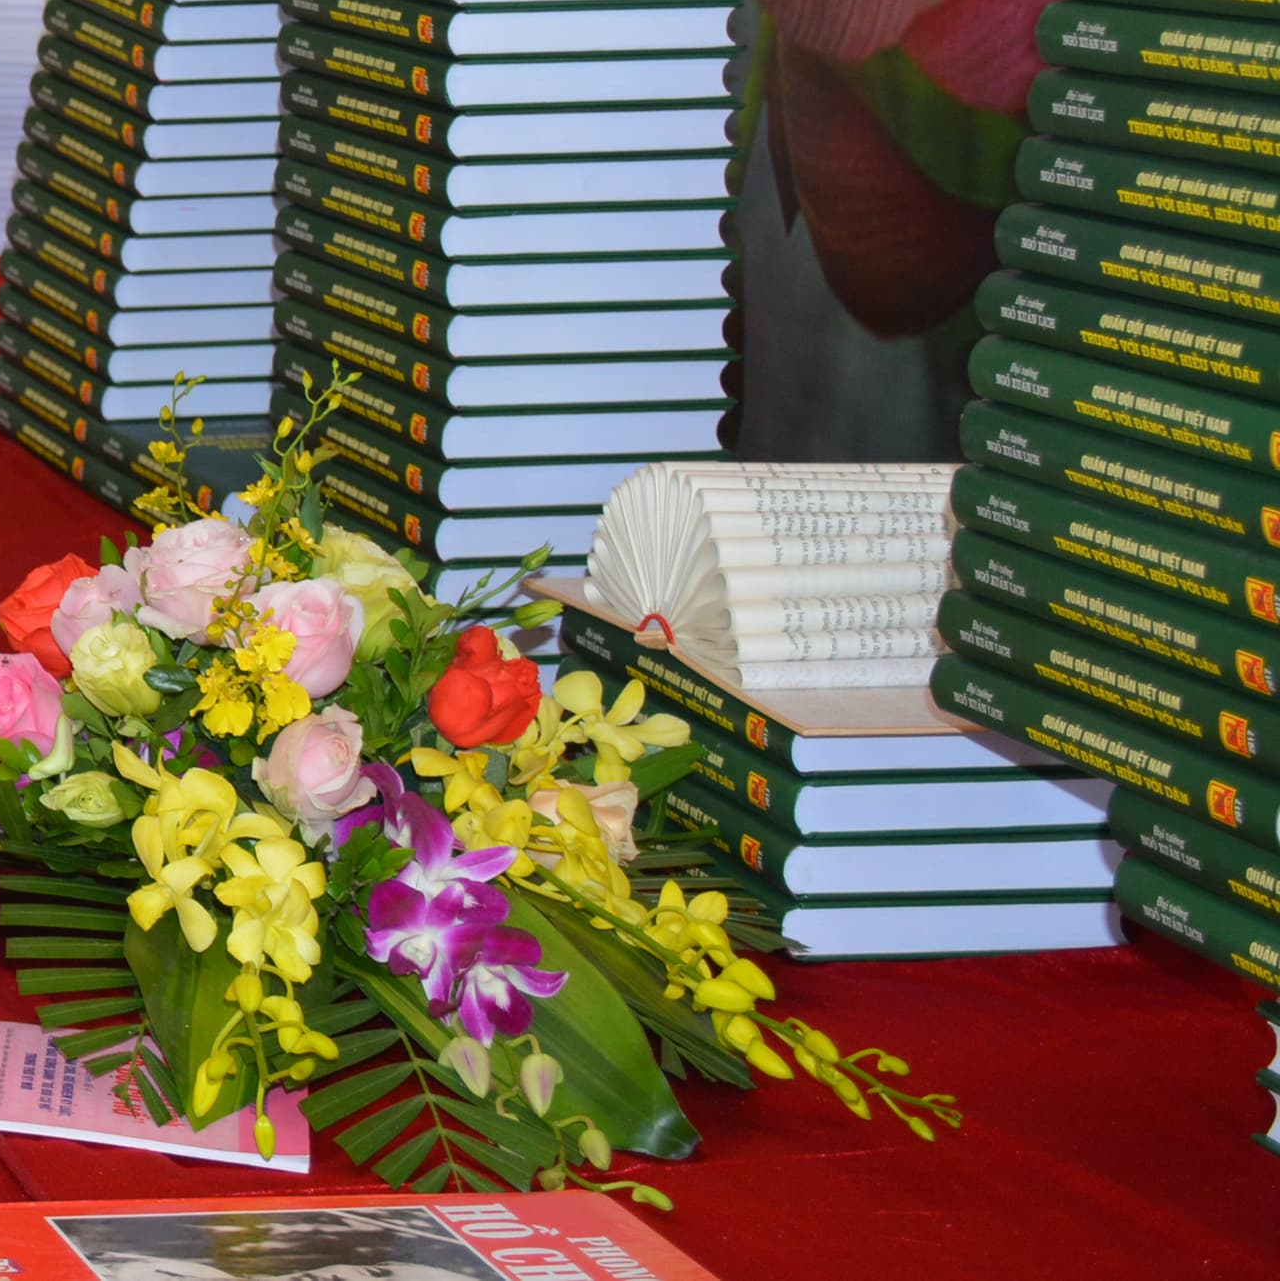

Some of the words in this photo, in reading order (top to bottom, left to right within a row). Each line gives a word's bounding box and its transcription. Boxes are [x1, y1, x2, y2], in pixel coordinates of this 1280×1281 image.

[1080, 330, 1120, 350] TRUNG
[1119, 338, 1140, 356] VỚI
[1209, 359, 1232, 377] VỚI
[1233, 364, 1262, 384] DÂN
[1216, 340, 1243, 359] NAM
[1042, 714, 1067, 734] QUÂN
[1082, 731, 1108, 751] NHÂN
[1107, 740, 1129, 760] DÂN
[1128, 749, 1150, 769] VIỆT
[1147, 758, 1171, 778] NAM
[1164, 785, 1190, 806] DÂN
[435, 1203, 561, 1240] HỒ
[490, 1247, 594, 1281] CH
[566, 1235, 662, 1281] PHON
